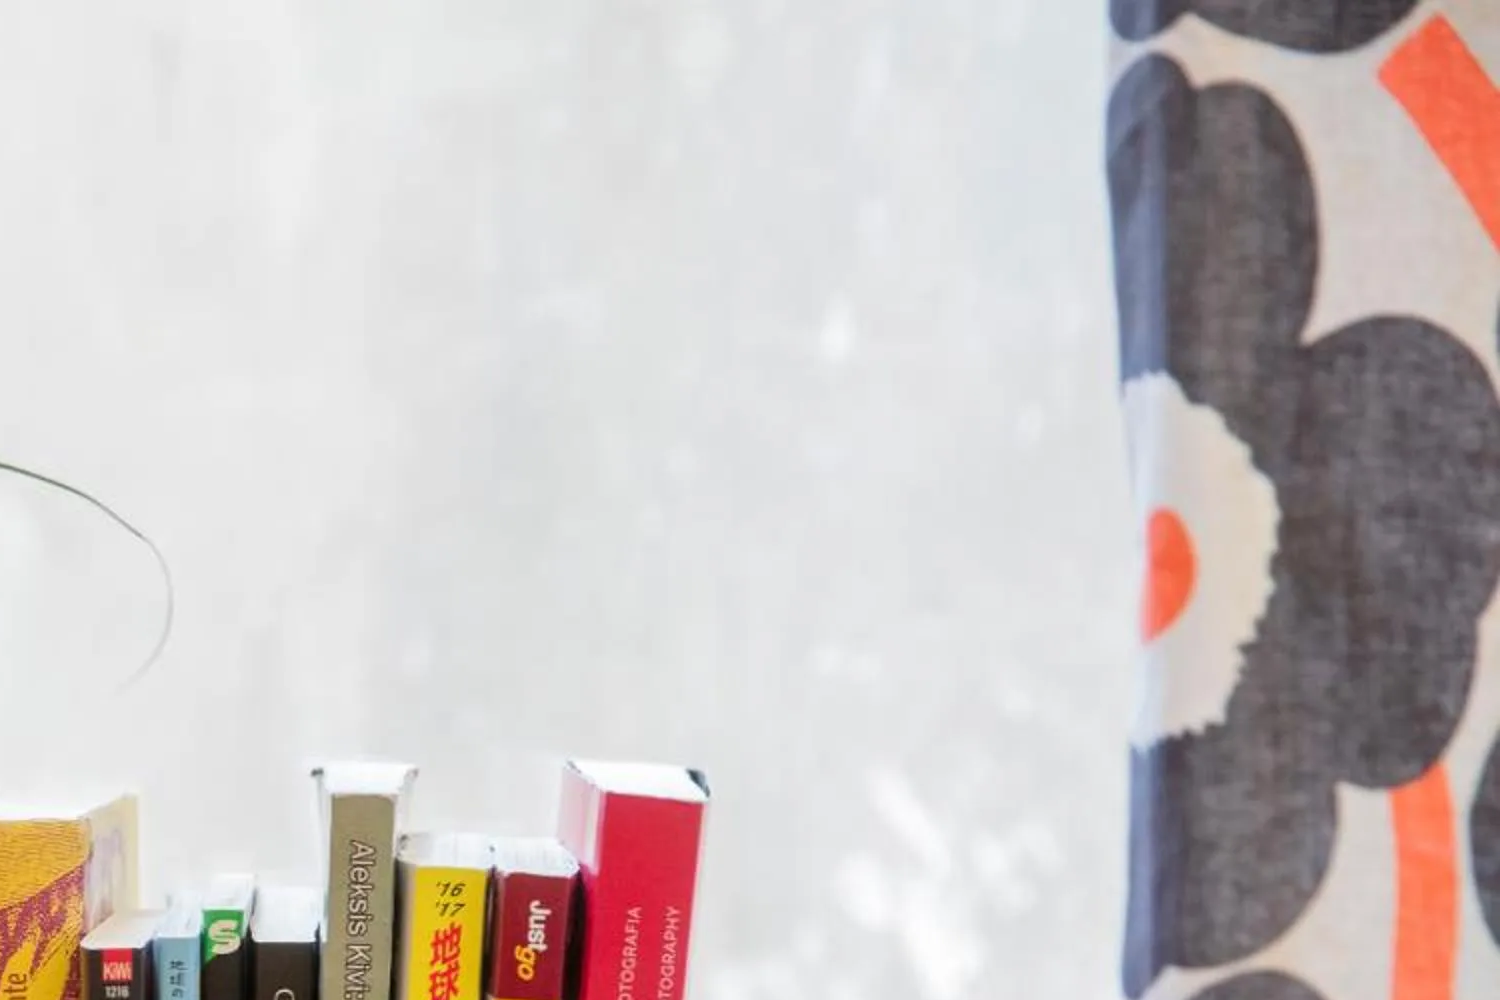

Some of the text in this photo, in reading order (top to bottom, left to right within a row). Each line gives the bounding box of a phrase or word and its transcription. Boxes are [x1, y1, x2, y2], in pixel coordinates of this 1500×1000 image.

[344, 839, 376, 938] Aleksis
[436, 882, 466, 897] '16
[435, 902, 466, 917] '17
[514, 900, 553, 981] Just go
[104, 985, 130, 998] 1216
